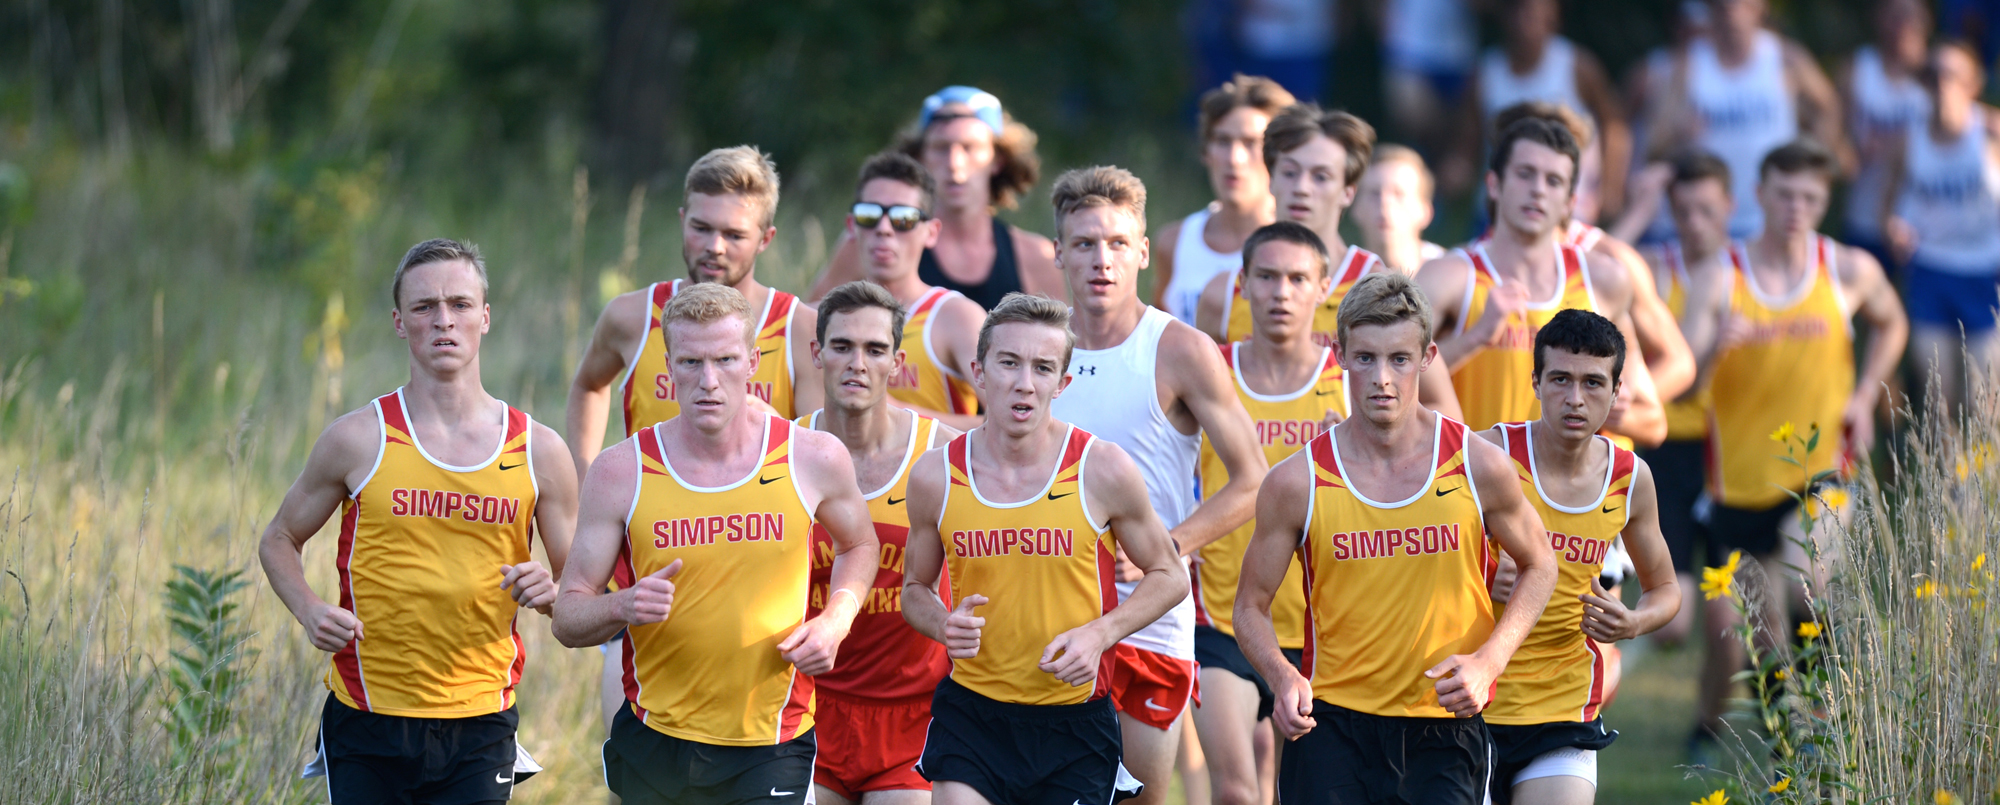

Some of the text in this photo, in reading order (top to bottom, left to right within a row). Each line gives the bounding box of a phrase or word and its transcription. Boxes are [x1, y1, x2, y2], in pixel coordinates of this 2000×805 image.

[392, 488, 519, 525] SIMPSON
[653, 512, 784, 549] SIMPSON
[952, 527, 1074, 558] SIMPSON
[1332, 523, 1459, 561] SIMPSON
[1546, 530, 1611, 565] PSON
